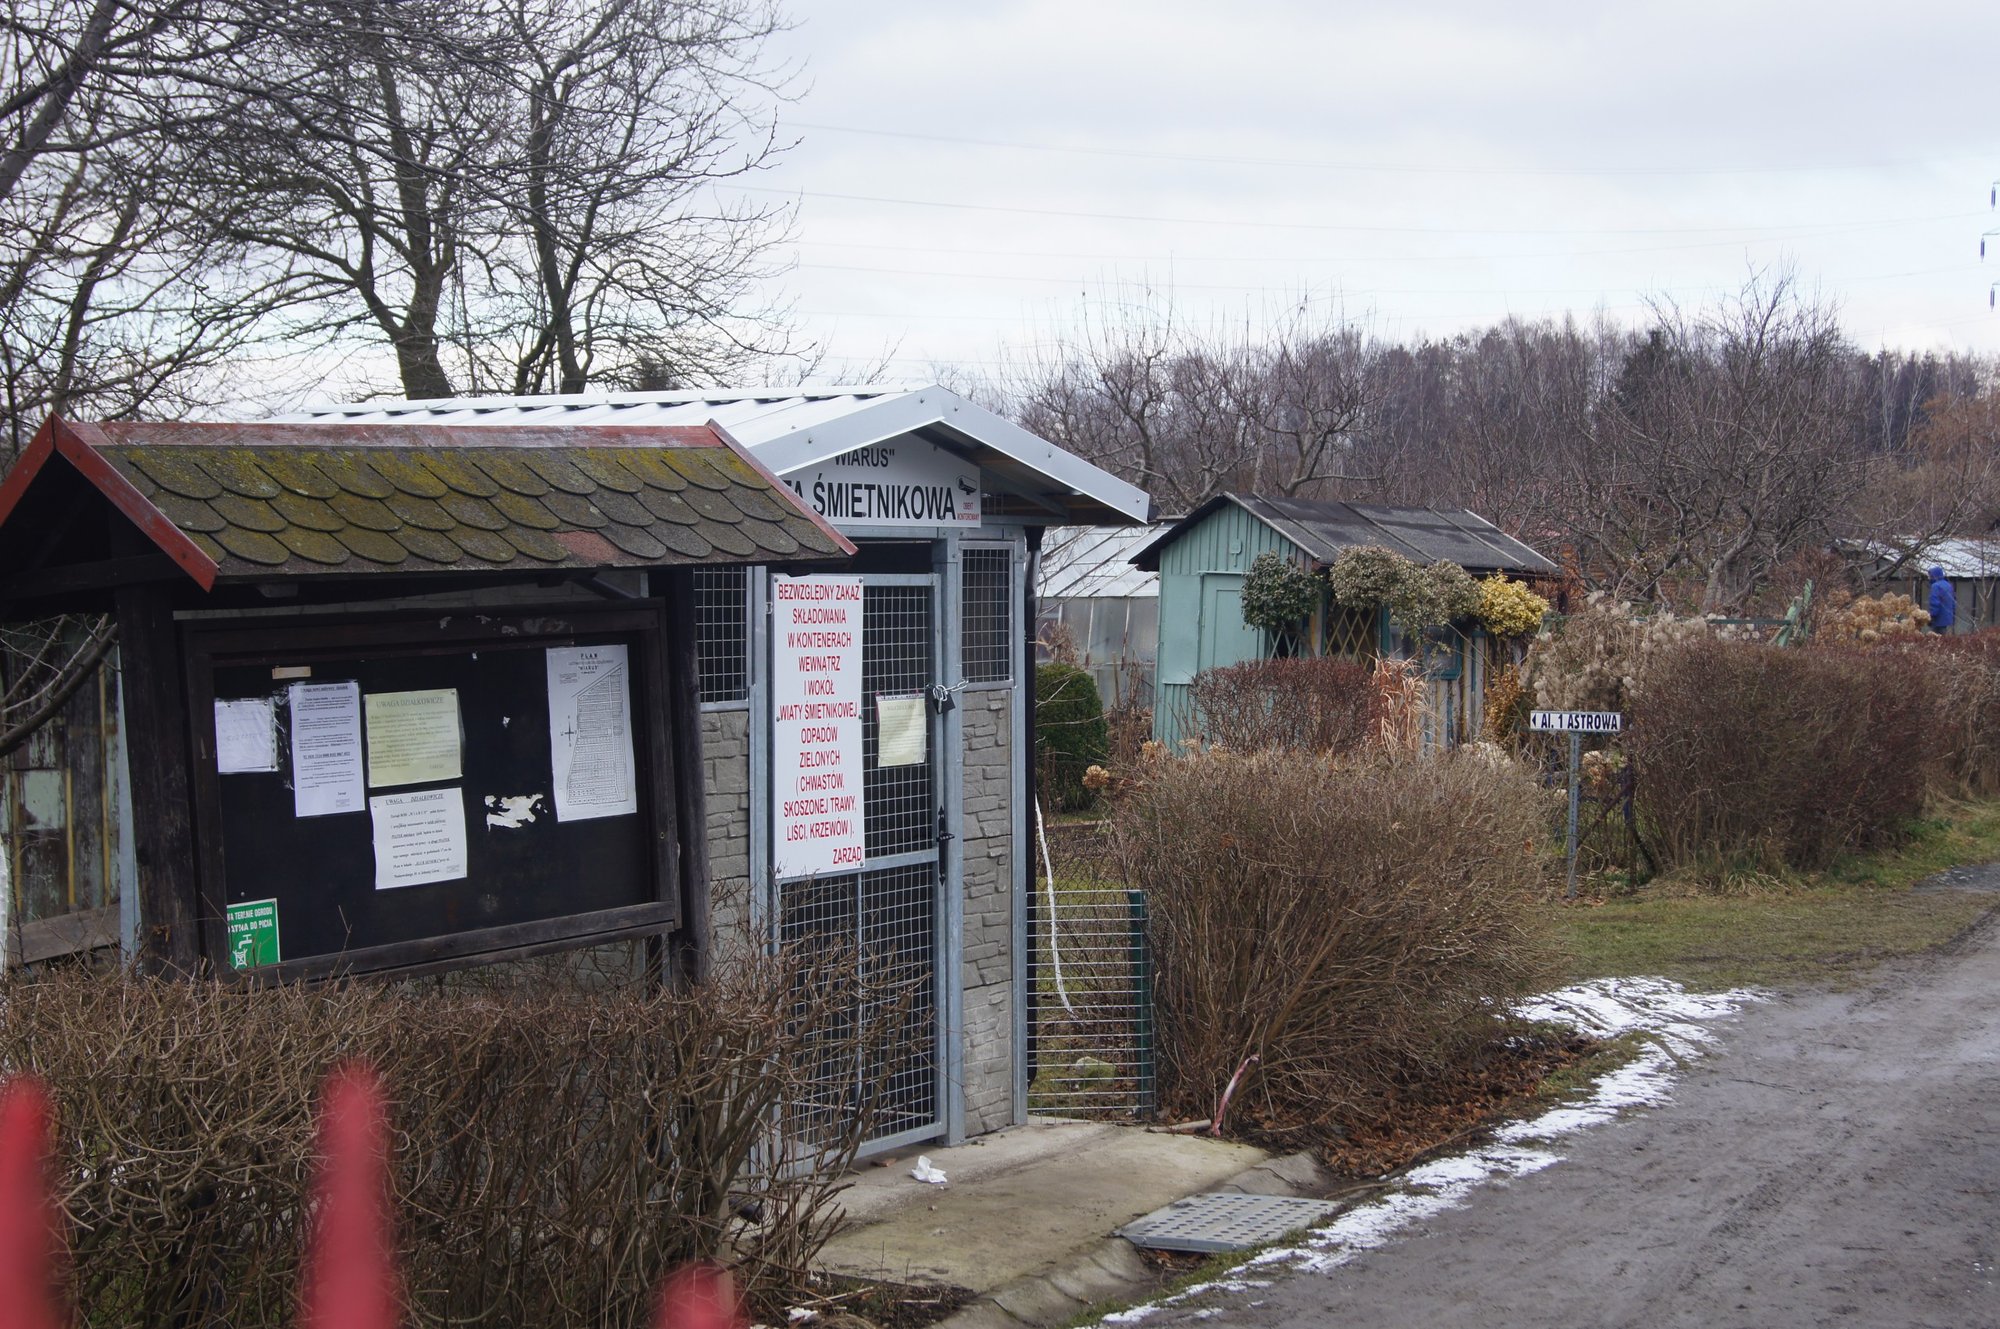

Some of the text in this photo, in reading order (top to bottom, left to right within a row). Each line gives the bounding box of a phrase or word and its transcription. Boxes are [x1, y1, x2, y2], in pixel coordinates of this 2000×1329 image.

[813, 473, 956, 520] ŚMIETNIKOWA
[778, 584, 860, 604] BEZWZGLĘDNY ZAKAZ
[793, 608, 847, 624] SKŁADOWANIA
[787, 632, 852, 648] W KONTENERACH
[799, 656, 841, 675] WEWNĄTRZ
[808, 676, 834, 696] WOKÓŁ
[780, 700, 857, 720] WIATY ŚMIETNIKOWEJ
[1558, 714, 1563, 728] 1
[1567, 714, 1618, 730] ASTROWA
[801, 723, 838, 744] ODPADÓW
[799, 750, 840, 768] ZIELONYCH
[784, 798, 828, 817] SKOSZONEJ
[810, 817, 848, 838] KRZEWÓW
[833, 846, 861, 866] ZARZĄD
[250, 921, 257, 930] DO
